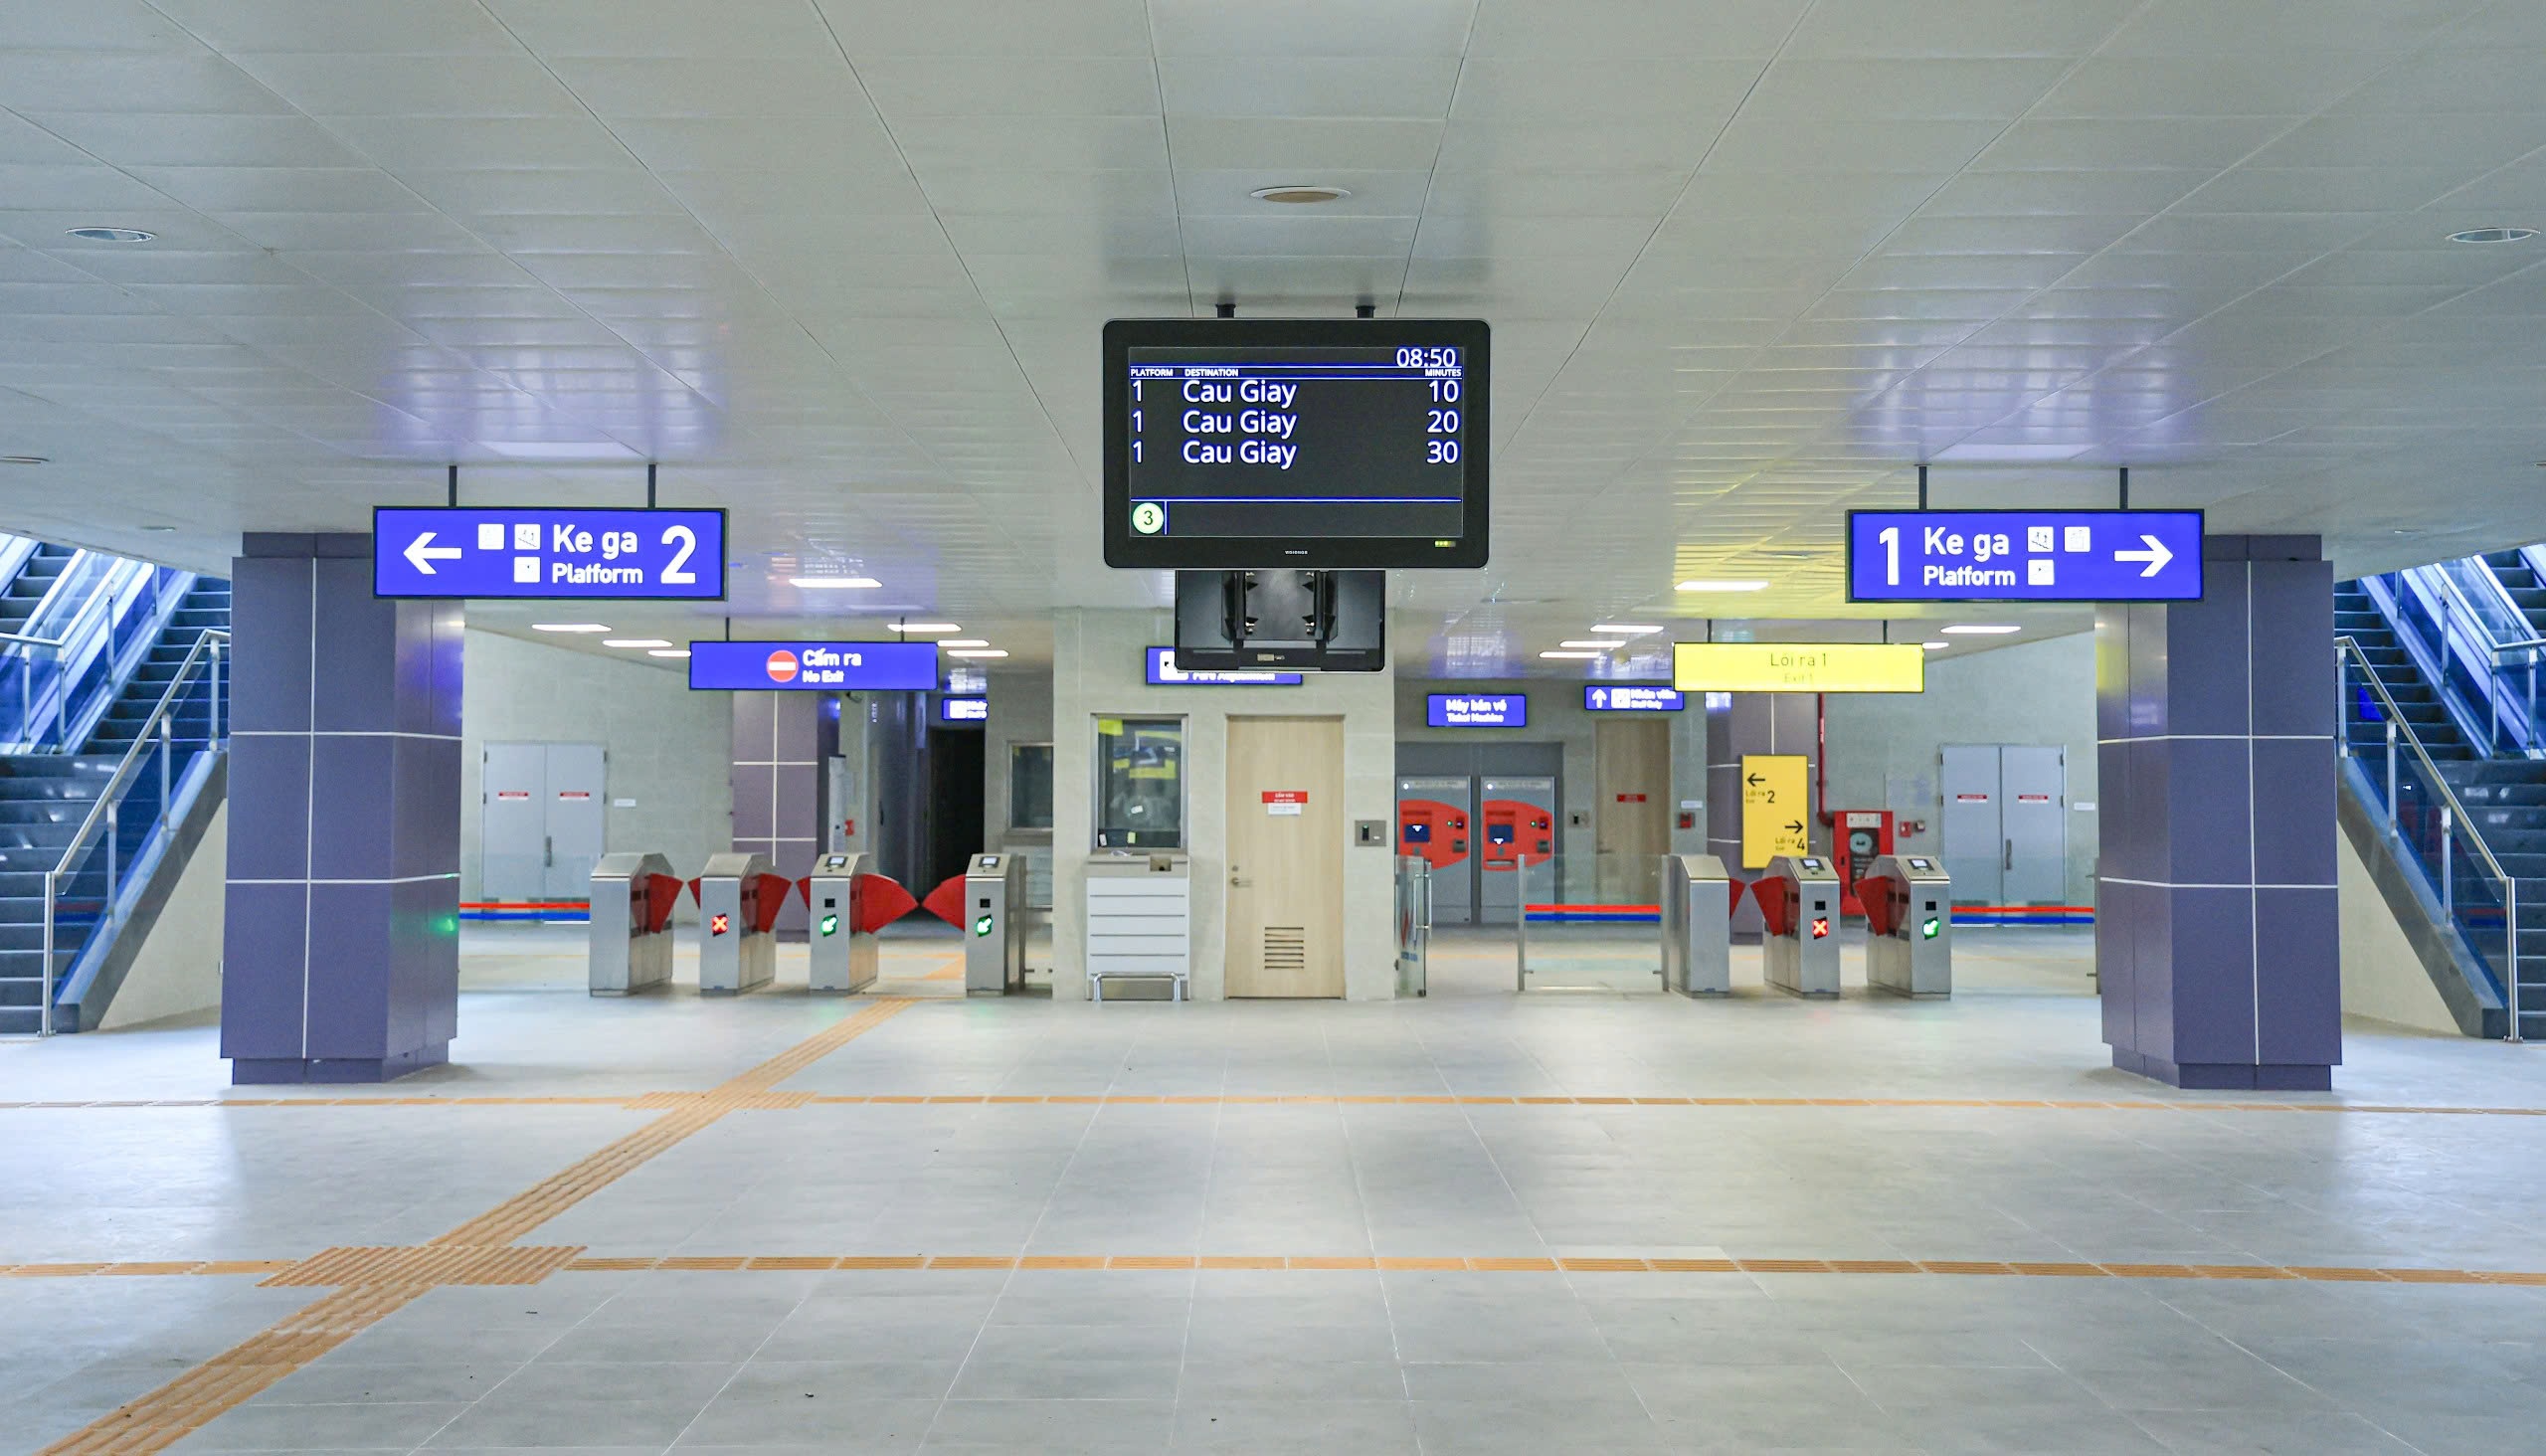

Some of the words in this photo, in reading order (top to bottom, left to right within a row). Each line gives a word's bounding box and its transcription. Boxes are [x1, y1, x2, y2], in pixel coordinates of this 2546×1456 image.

[1396, 348, 1457, 368] 08:50
[1132, 380, 1143, 403] 1
[1182, 380, 1232, 403] Cau
[1239, 380, 1297, 410] Giay
[1428, 380, 1459, 403] 10
[1132, 410, 1143, 433] 1
[1182, 410, 1232, 433] Cau
[1239, 410, 1297, 440] Giay
[1426, 410, 1459, 433] 20
[1132, 441, 1143, 463] 1
[1182, 441, 1232, 463] Cau
[1239, 441, 1297, 470] Giay
[1426, 441, 1459, 463] 30
[1144, 510, 1154, 525] 3
[552, 524, 594, 553] Ke
[602, 531, 637, 560] ga
[1923, 526, 1964, 555] Ke
[1973, 533, 2010, 562] ga
[660, 524, 697, 585] 2
[1879, 527, 1900, 586] 1
[552, 563, 643, 585] Platform
[1923, 565, 2016, 586] Platform
[843, 653, 862, 666] ra
[1799, 656, 1815, 666] ra
[803, 669, 820, 682] No
[821, 669, 844, 682] Exit
[1767, 790, 1775, 804] 2
[1796, 837, 1805, 850] 4
